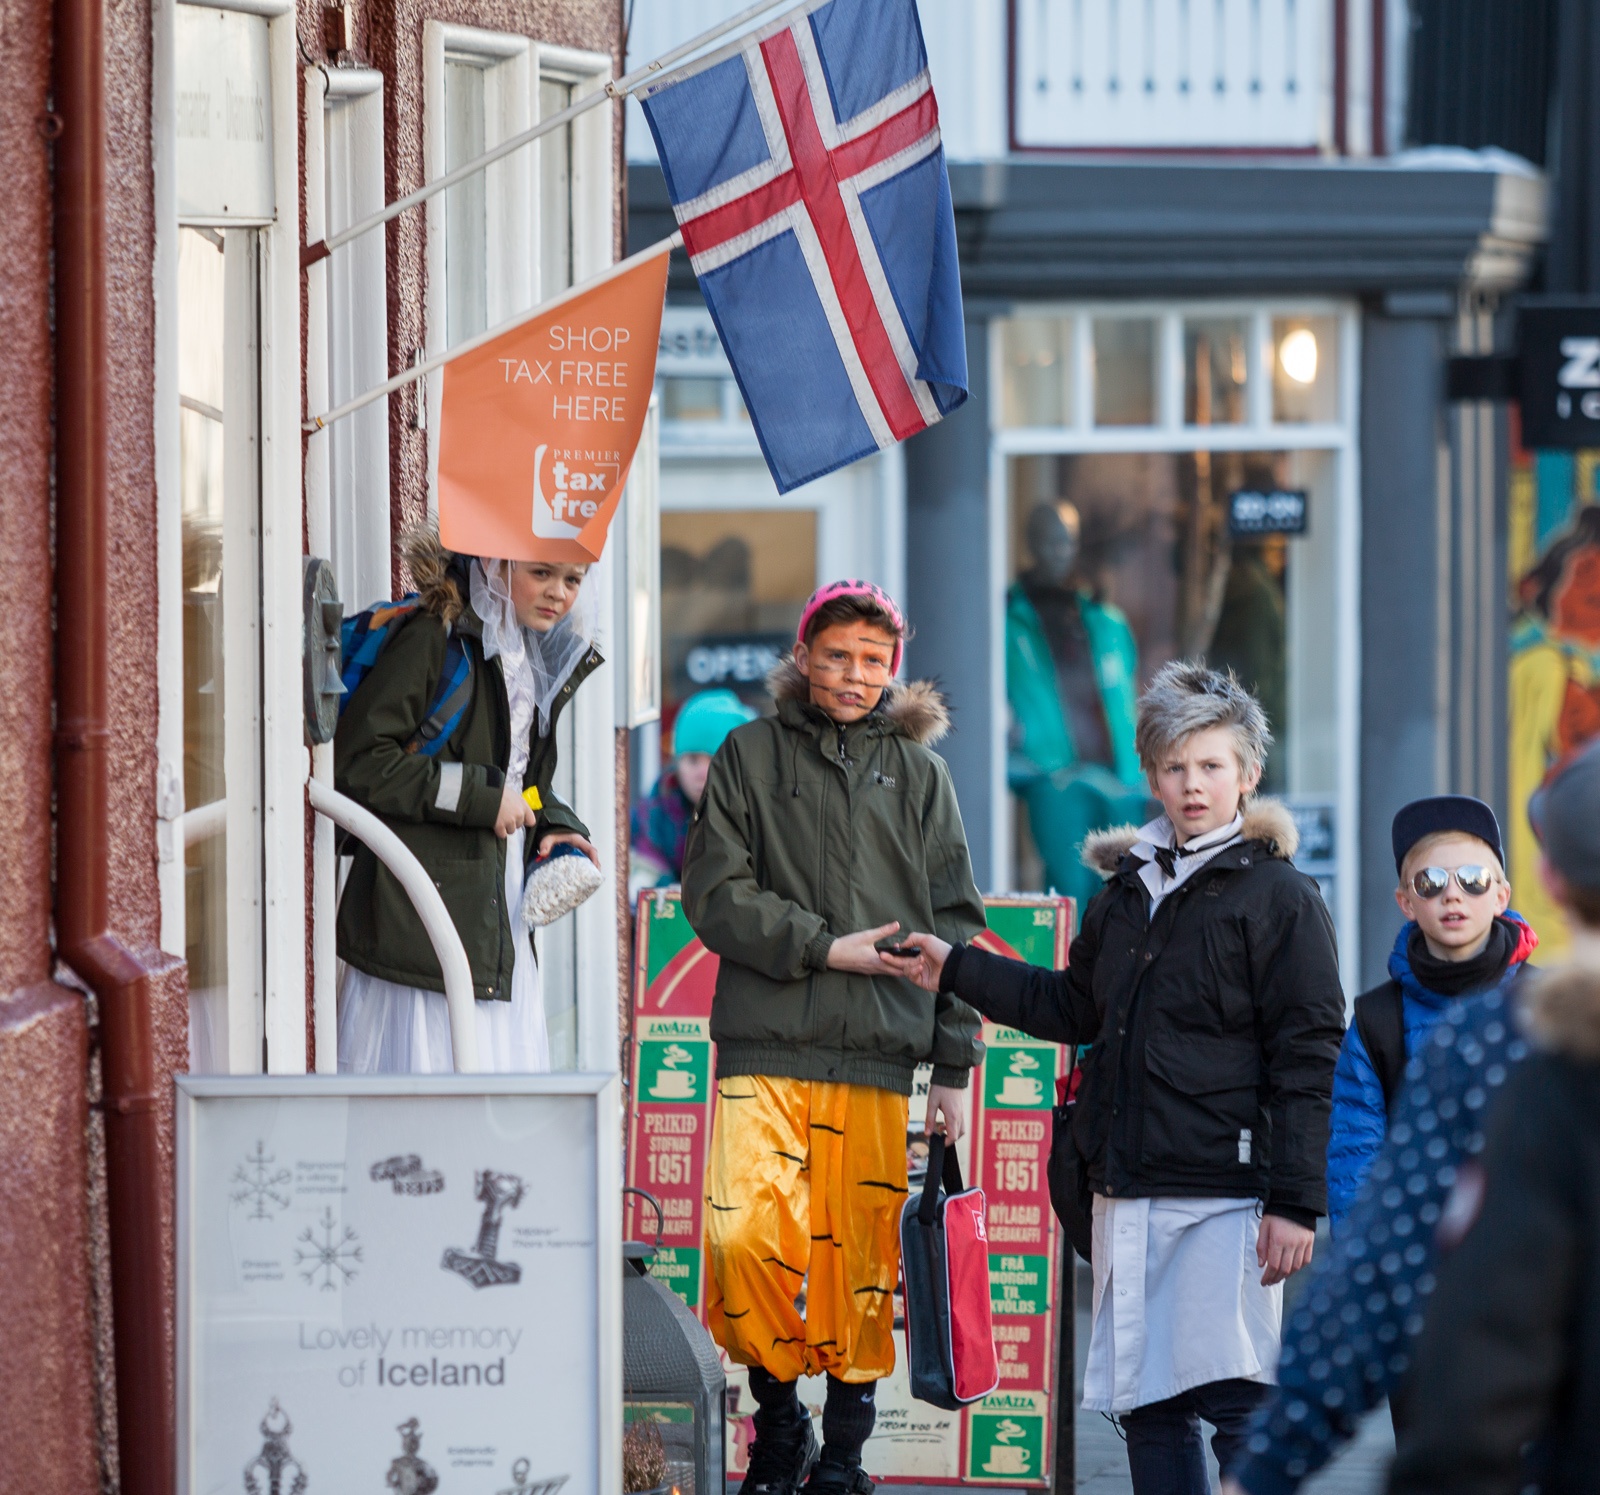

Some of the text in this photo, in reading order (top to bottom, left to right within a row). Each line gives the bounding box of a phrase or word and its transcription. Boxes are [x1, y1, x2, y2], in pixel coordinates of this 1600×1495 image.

[549, 326, 631, 352] SHOP
[498, 359, 628, 387] TAX FREE
[553, 396, 626, 422] HERE
[553, 449, 621, 461] PREMIER
[553, 461, 606, 490] tax
[1033, 909, 1054, 927] 12
[649, 1022, 701, 1035] LAVAZZA
[643, 1113, 697, 1134] PRIKIÐ
[989, 1120, 1045, 1141] PRIKIÐ
[647, 1154, 692, 1184] 1951
[994, 1160, 1039, 1192] 1951
[988, 1201, 1041, 1225] NÝLAGAÐ
[1000, 1255, 1025, 1271] FRÁ
[1002, 1286, 1020, 1299] TIL
[299, 1322, 523, 1354] Lovely memory
[1001, 1344, 1018, 1361] OG
[338, 1357, 505, 1387] of Iceland
[981, 1395, 1035, 1408] LAVAZZA
